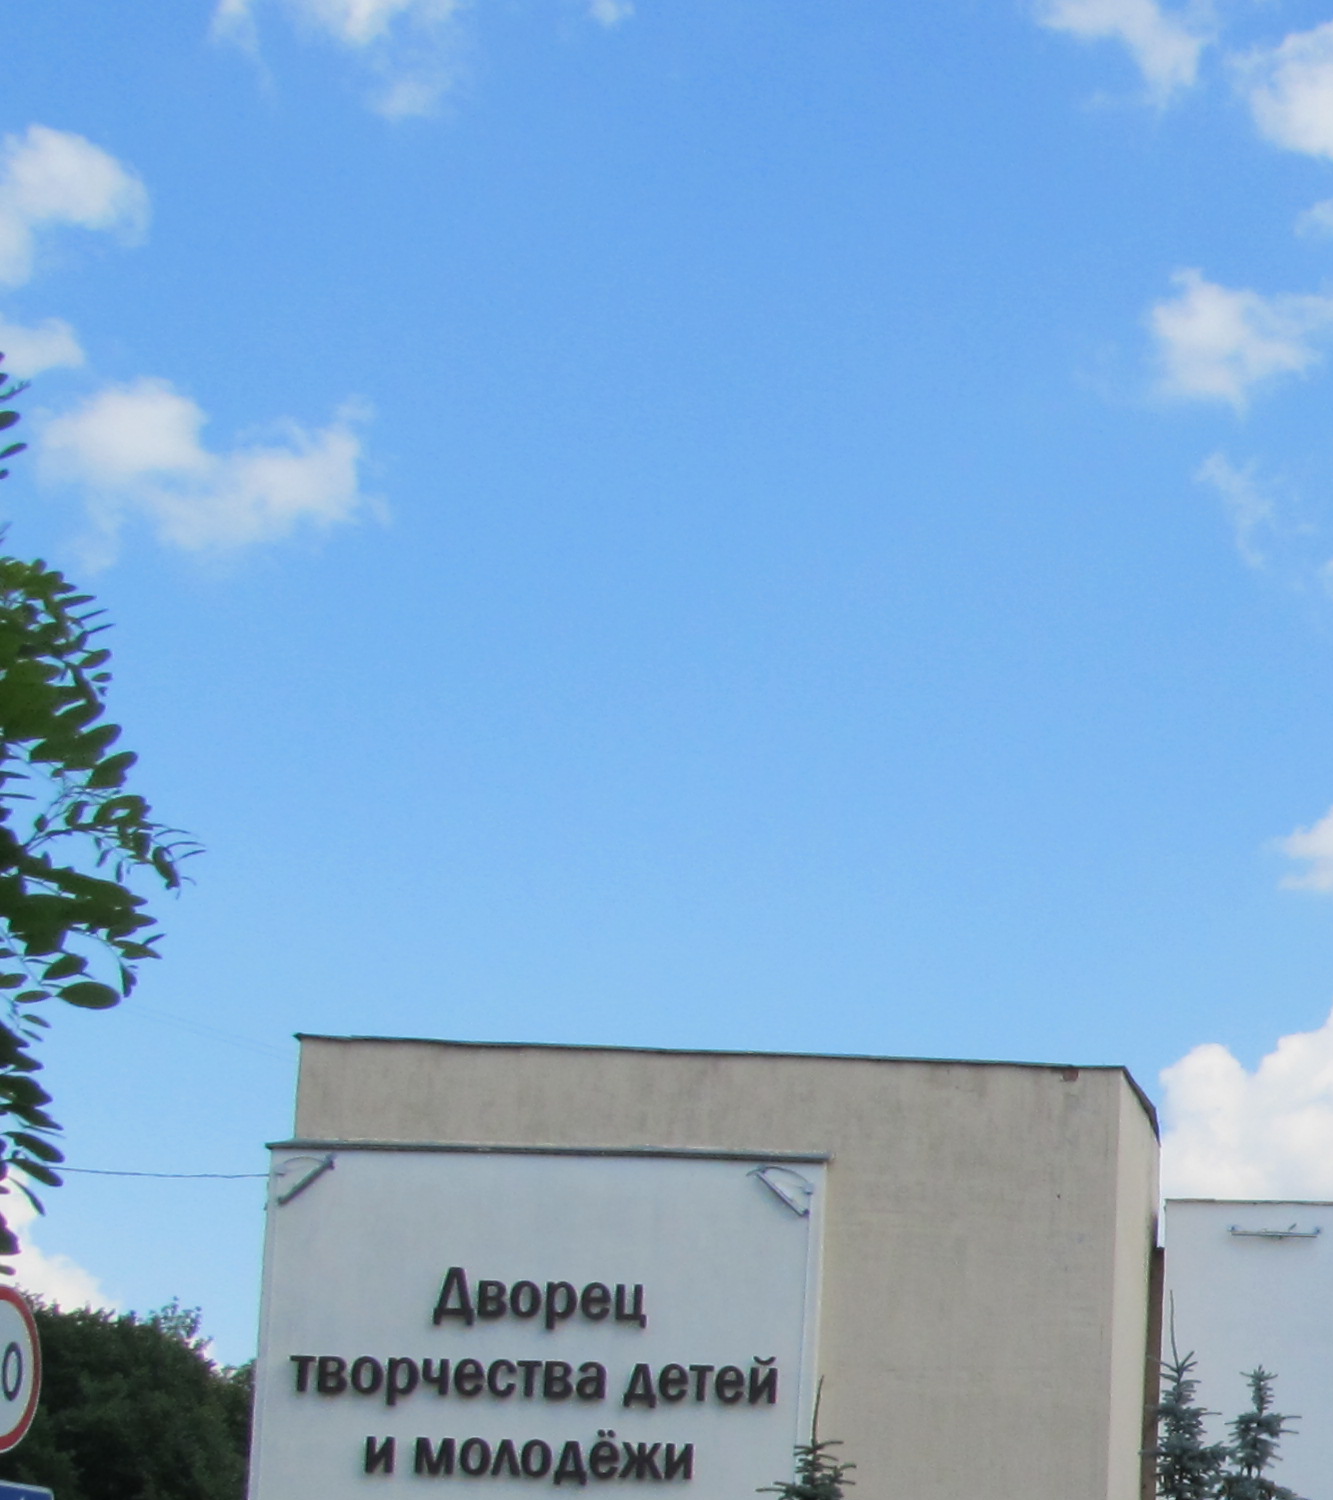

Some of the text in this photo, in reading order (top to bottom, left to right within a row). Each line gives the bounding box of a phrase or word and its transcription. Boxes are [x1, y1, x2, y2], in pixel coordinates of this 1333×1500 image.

[433, 1267, 648, 1330] Дворец
[2, 1342, 22, 1401] 0
[290, 1355, 778, 1409] творчества детей
[364, 1430, 695, 1486] и молодёжи
